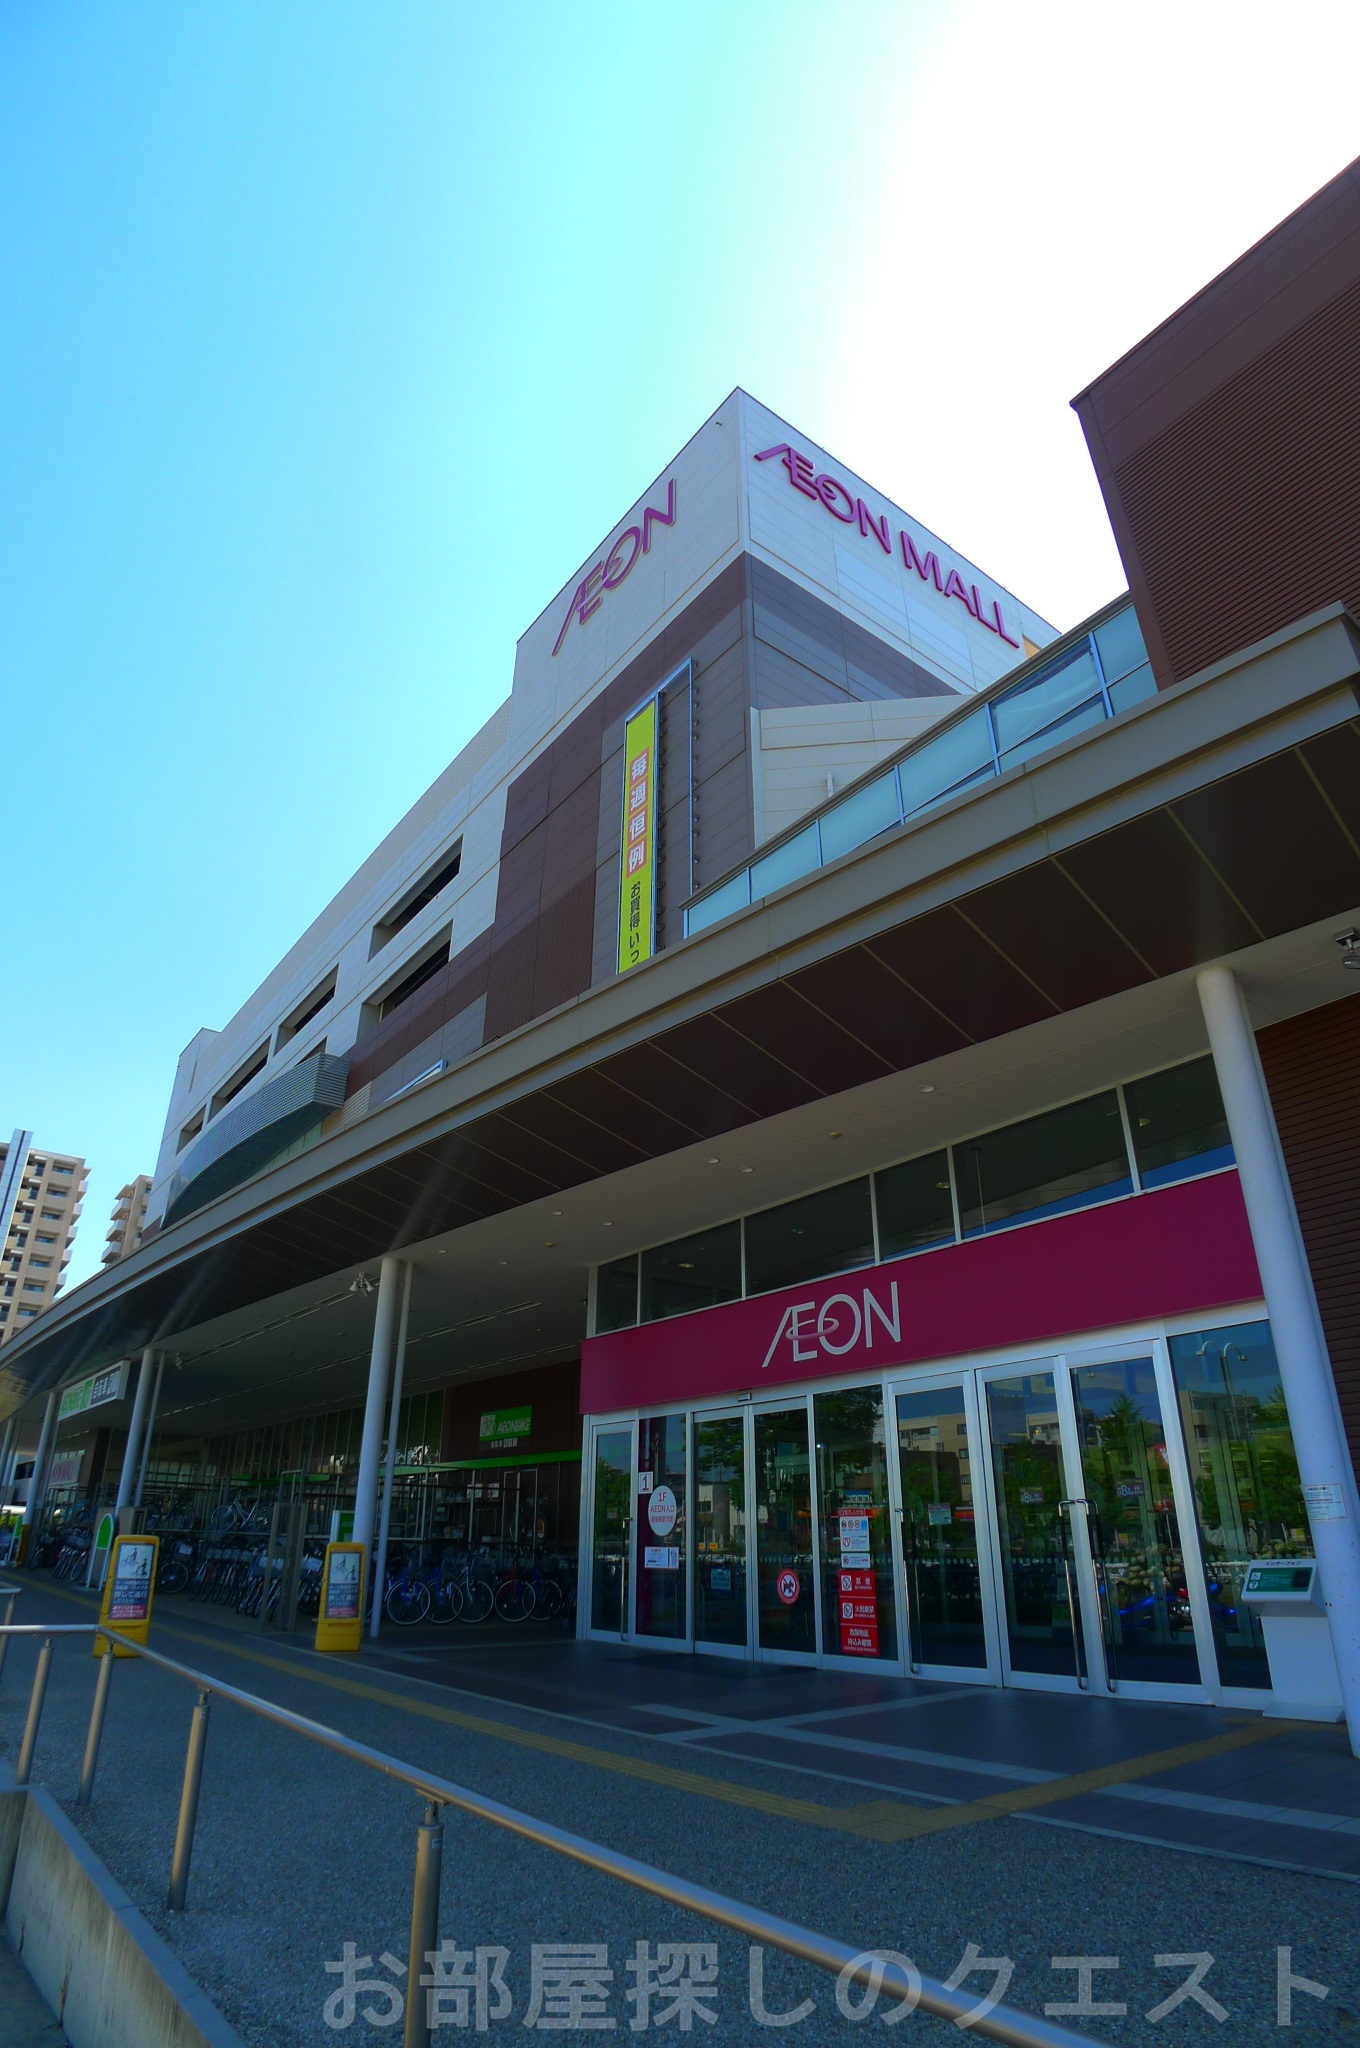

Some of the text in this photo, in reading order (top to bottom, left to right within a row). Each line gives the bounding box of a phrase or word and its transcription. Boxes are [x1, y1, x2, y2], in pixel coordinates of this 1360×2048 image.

[900, 530, 1021, 649] MALL
[629, 753, 648, 872] 毎週恒例
[629, 881, 641, 965] お買得いつ
[642, 1474, 650, 1491] 1
[658, 1491, 667, 1502] 1F
